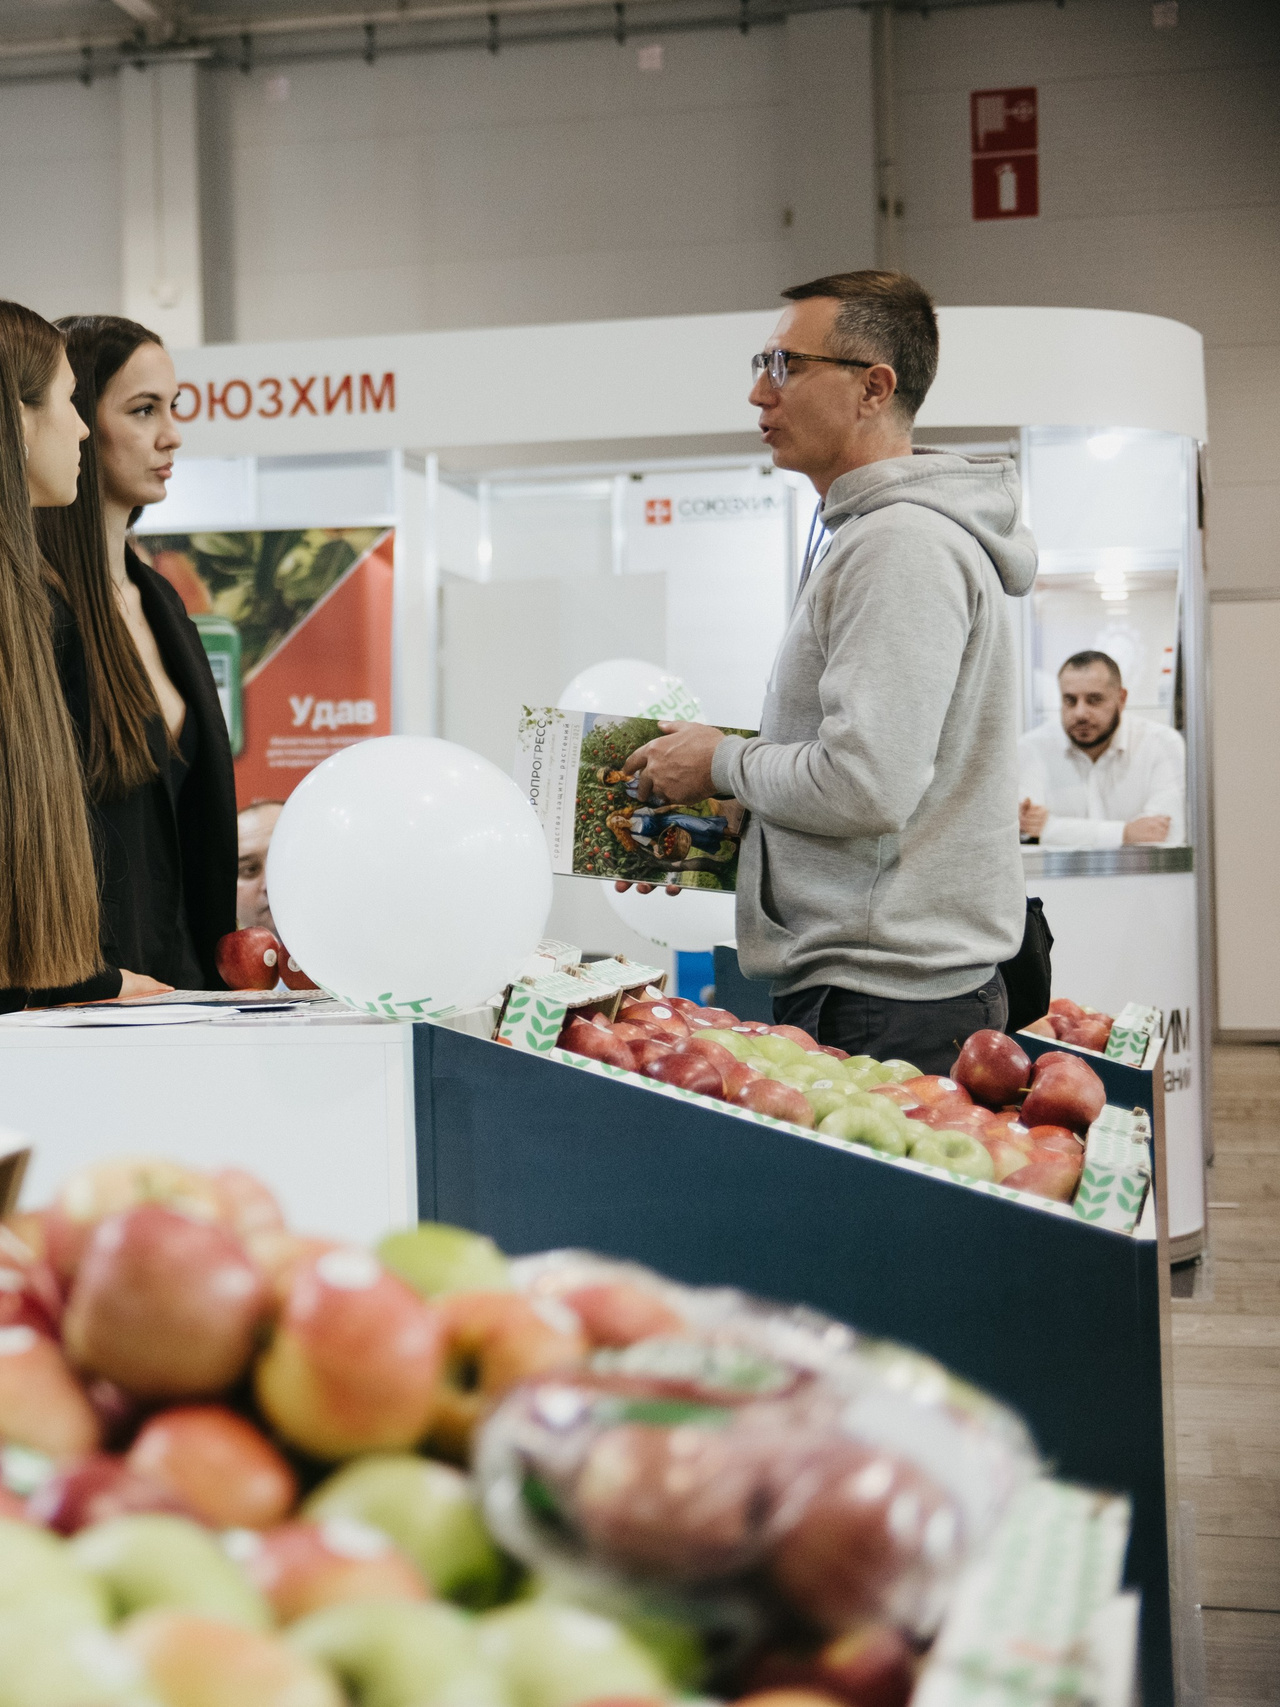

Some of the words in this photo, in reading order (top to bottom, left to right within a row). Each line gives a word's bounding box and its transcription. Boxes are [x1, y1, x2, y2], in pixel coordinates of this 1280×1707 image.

[288, 695, 376, 730] Удав
[560, 723, 570, 770] растений
[529, 719, 548, 829] РОПРОГРЕСС
[556, 774, 564, 811] защиты
[553, 815, 561, 859] средства
